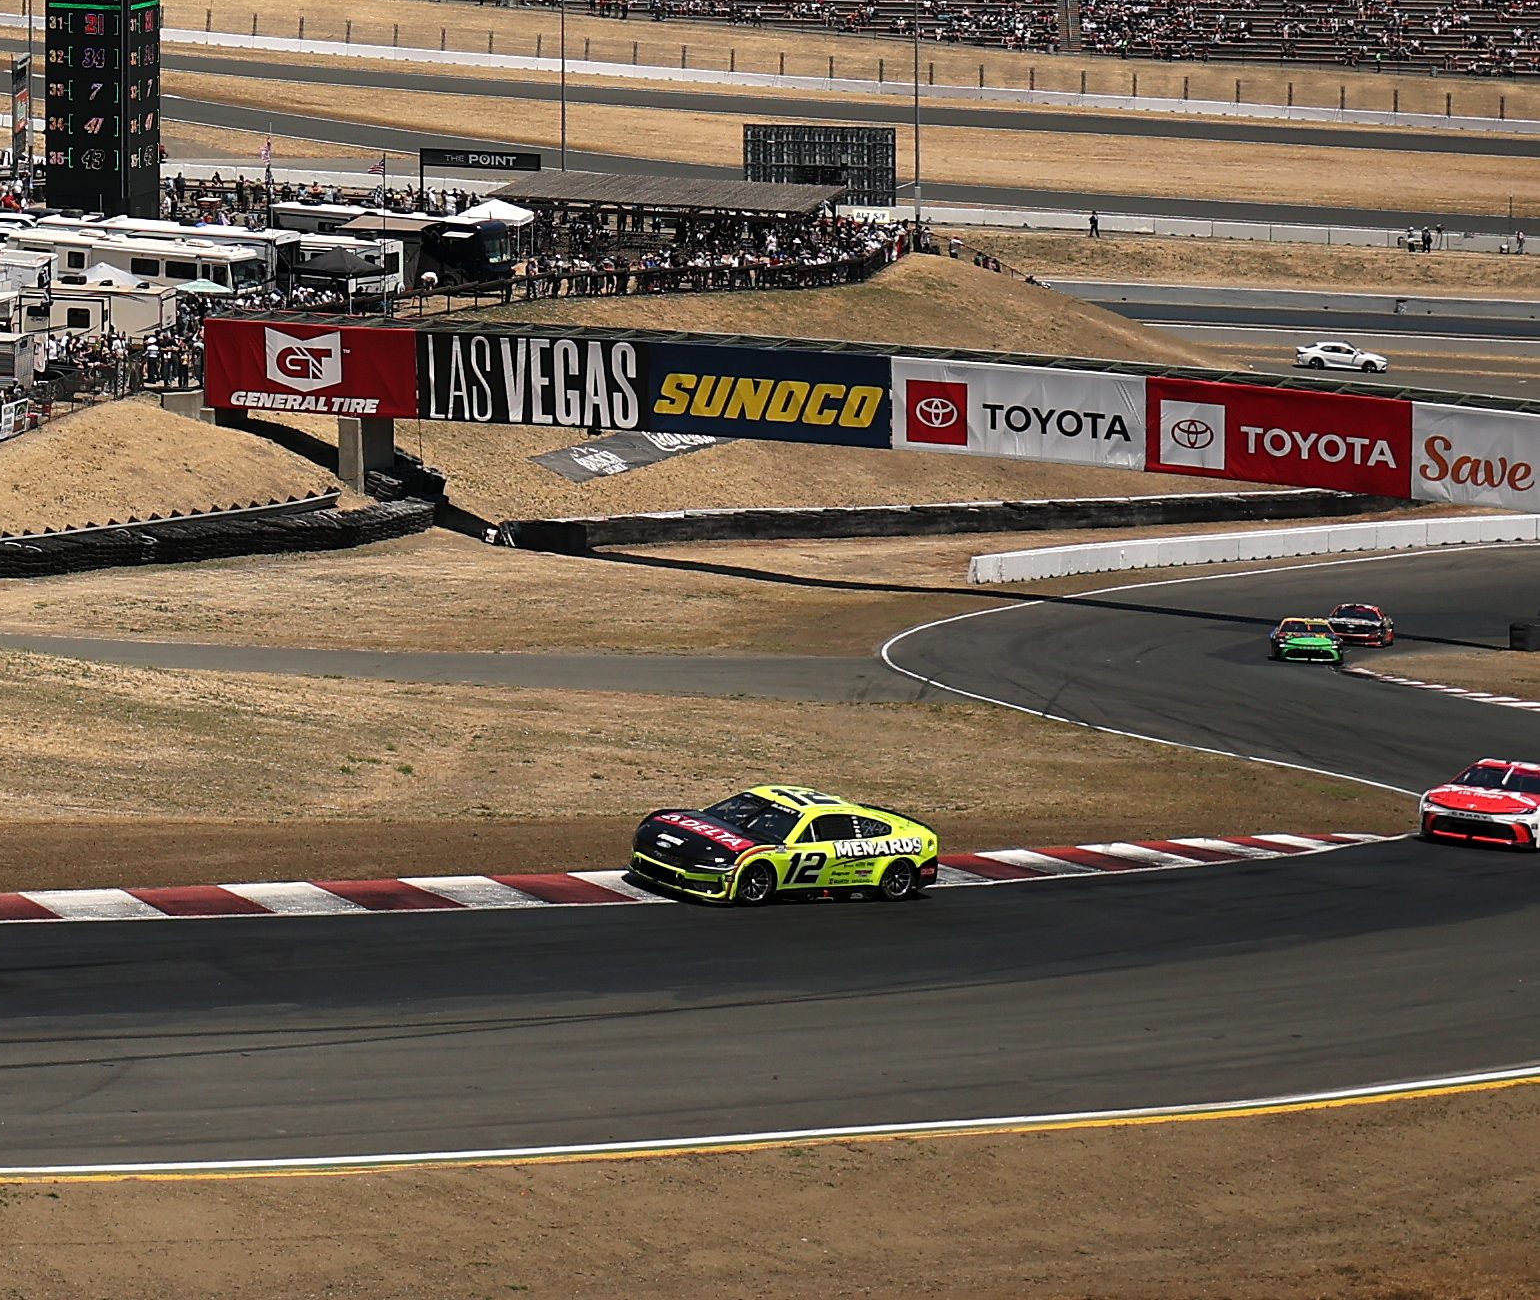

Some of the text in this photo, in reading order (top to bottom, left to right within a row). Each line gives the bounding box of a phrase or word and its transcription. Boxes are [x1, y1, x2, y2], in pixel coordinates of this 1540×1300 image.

[49, 15, 64, 29] 31
[85, 13, 105, 35] 21
[49, 50, 64, 63] 32
[82, 48, 106, 69] 34
[89, 83, 103, 100] 7
[84, 117, 104, 134] 41
[49, 151, 64, 165] 35
[81, 149, 106, 170] 43
[444, 154, 517, 166] THE POINT
[276, 346, 332, 380] GT
[427, 334, 638, 429] LAS VEGAS
[230, 391, 380, 414] GENERAL TIRE
[654, 373, 883, 428] SUNOCO
[982, 403, 1131, 441] TOYOTA
[1240, 425, 1397, 469] TOYOTA
[1419, 435, 1535, 491] Save
[680, 819, 743, 847] DELTA
[834, 837, 922, 858] MENARDS
[783, 852, 827, 885] 12
